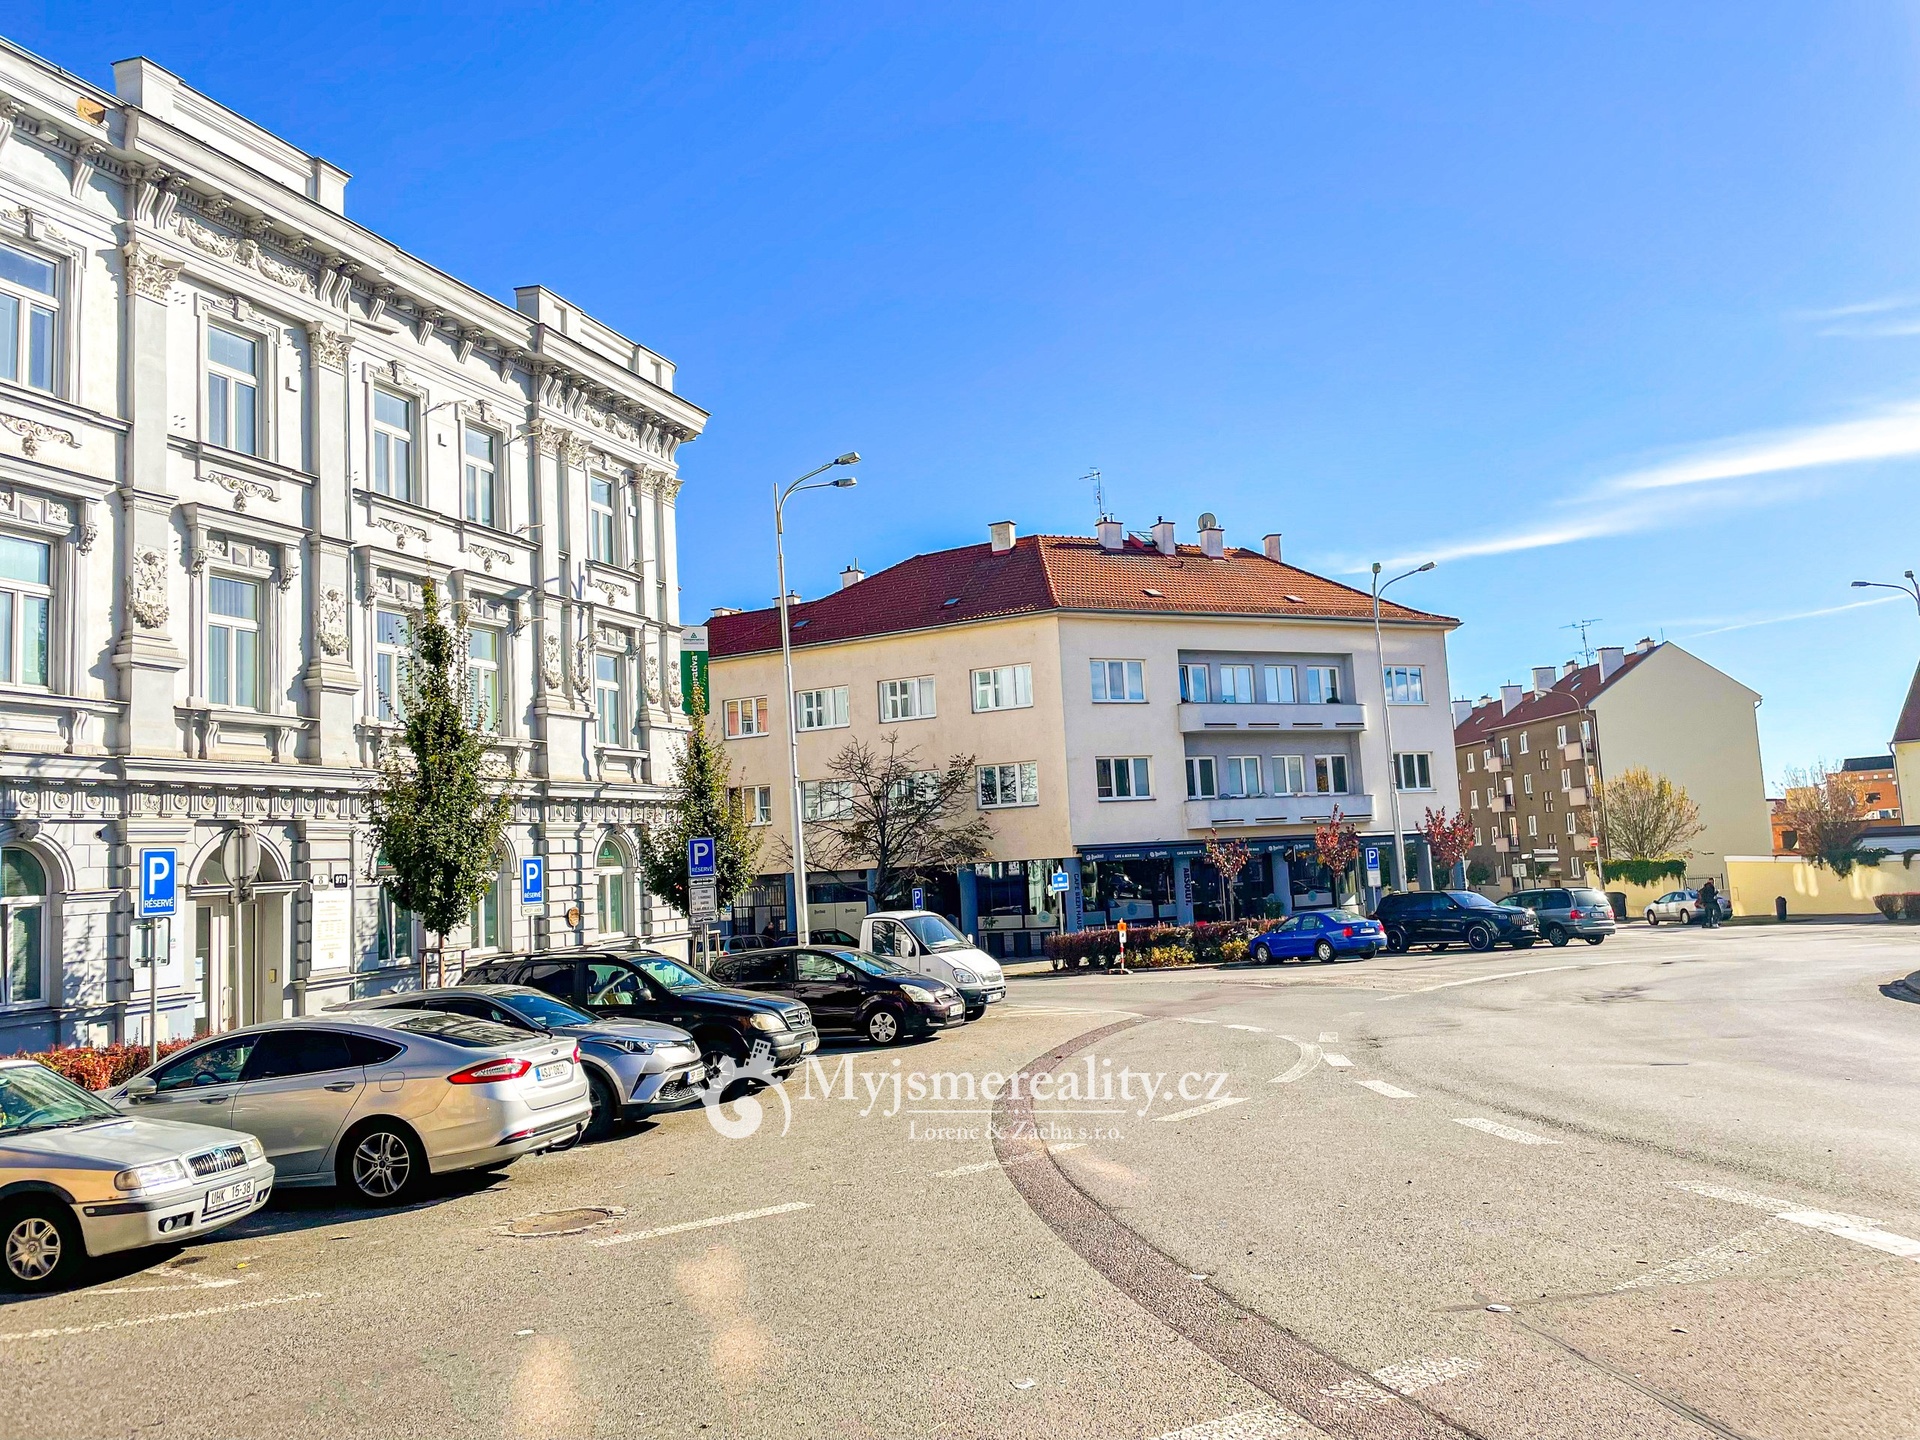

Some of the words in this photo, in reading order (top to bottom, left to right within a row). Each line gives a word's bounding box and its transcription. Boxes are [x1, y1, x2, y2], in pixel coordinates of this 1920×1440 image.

[694, 843, 709, 865] P
[1369, 850, 1376, 864] P
[149, 857, 170, 895] P
[526, 863, 538, 890] P
[691, 865, 713, 873] RÉSERVÉ
[144, 897, 174, 908] RÉSERVÉ
[914, 890, 921, 904] P
[211, 1189, 226, 1204] UHK
[232, 1181, 252, 1198] 15-38
